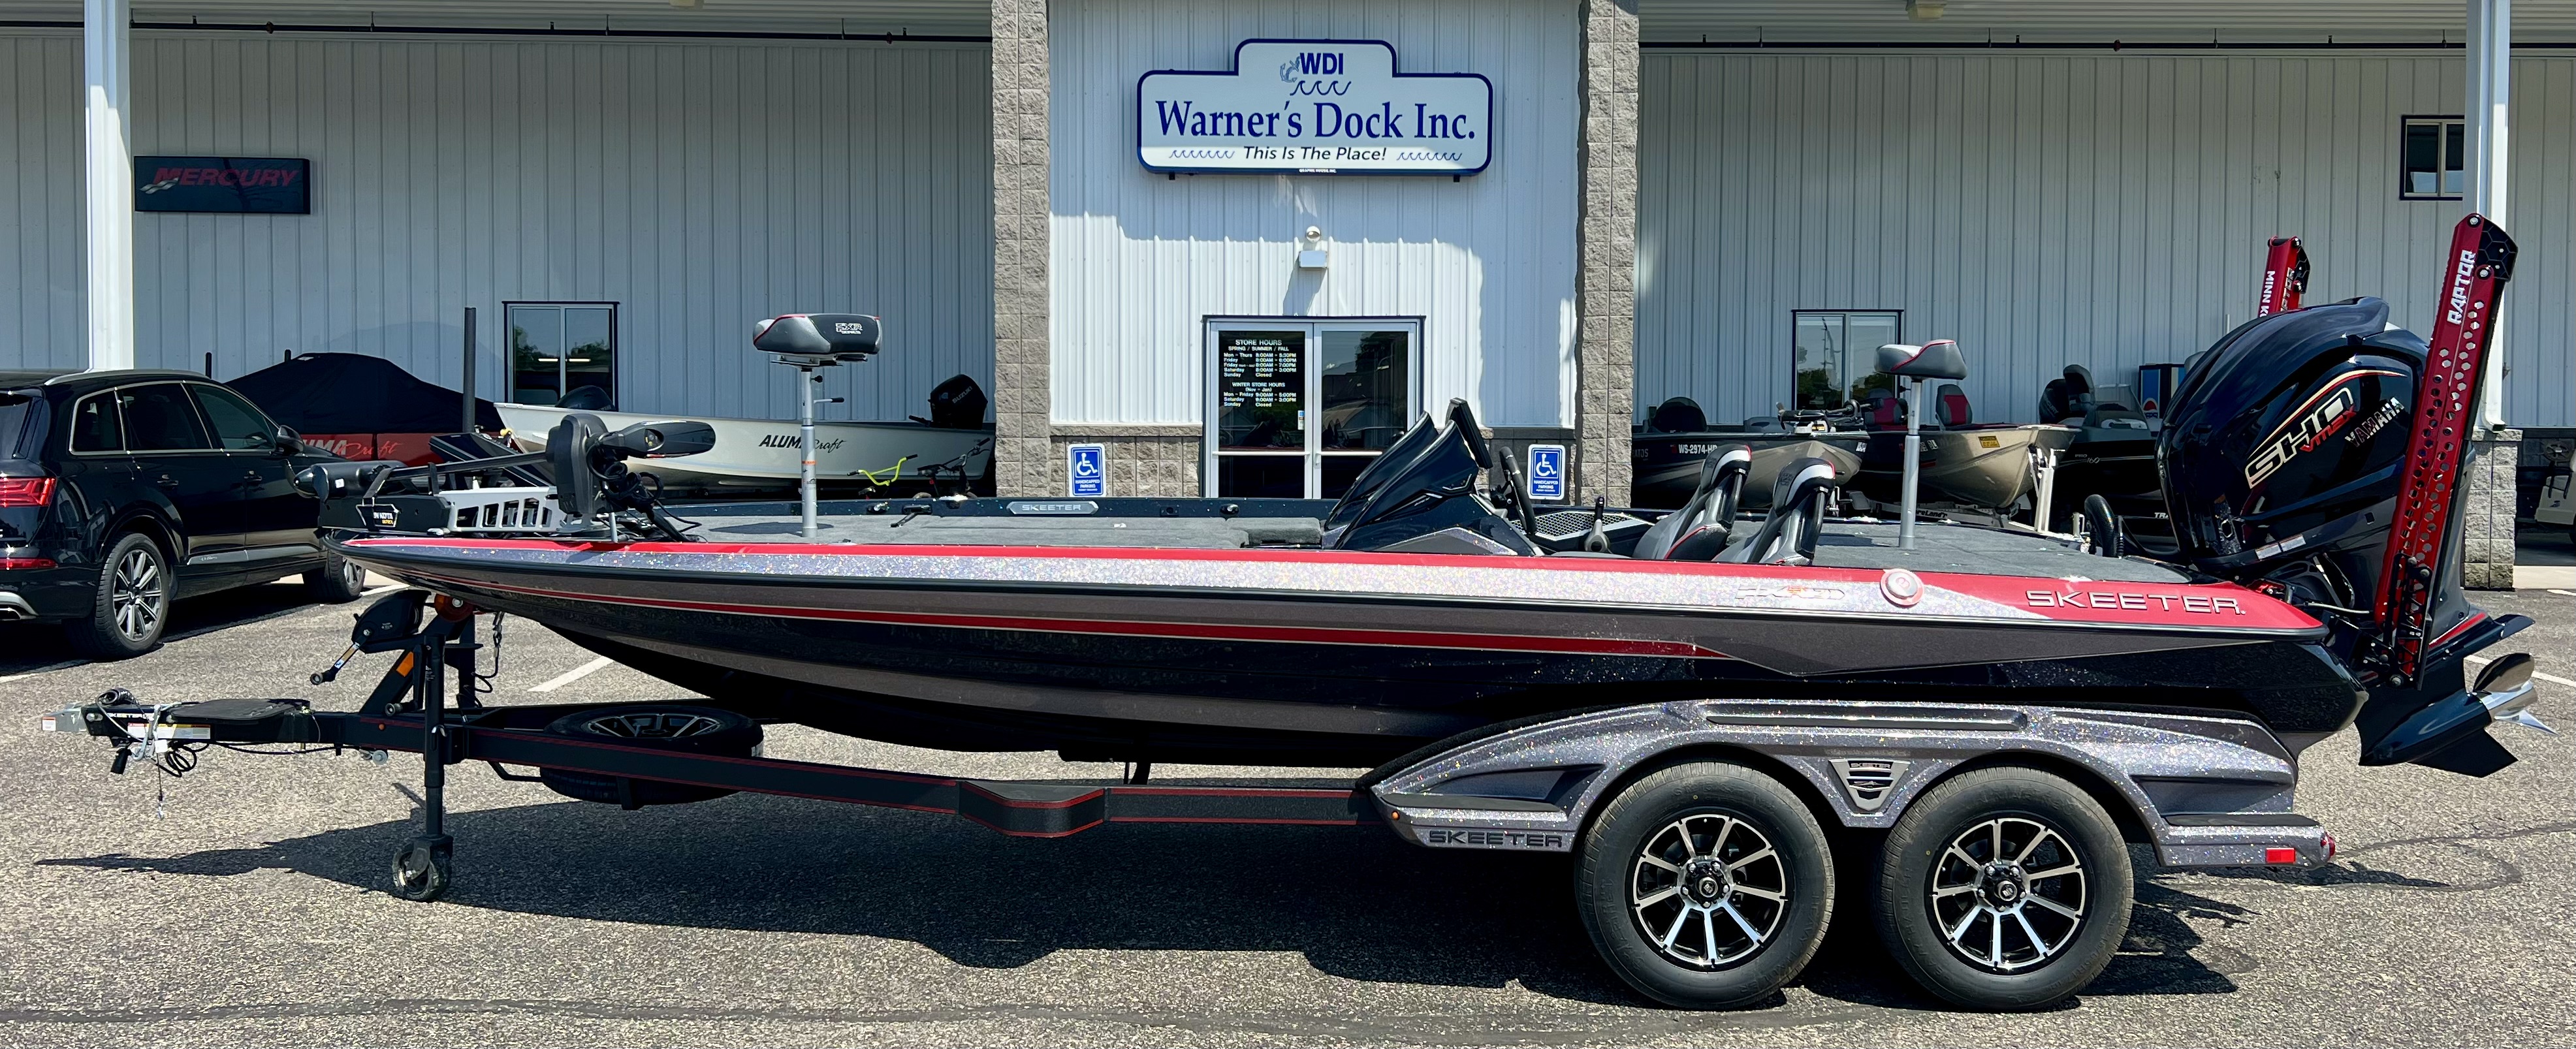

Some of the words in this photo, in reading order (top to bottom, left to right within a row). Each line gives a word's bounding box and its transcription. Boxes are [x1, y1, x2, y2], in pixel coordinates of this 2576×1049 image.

[1299, 53, 1344, 75] WDI
[1155, 100, 1303, 138] Warner's
[1313, 101, 1404, 139] Dock
[1414, 102, 1475, 140] Inc.
[1243, 146, 1277, 159] This
[1282, 146, 1295, 160] Is
[1300, 146, 1331, 160] The
[1336, 147, 1387, 161] Place!
[153, 167, 298, 187] MERCURY
[2262, 270, 2275, 303] MINN
[2447, 249, 2475, 325] RAPTOR
[2344, 397, 2405, 448] YAMAHA
[758, 434, 802, 449] ALUM
[2026, 589, 2242, 615] SKEETER
[1429, 830, 1563, 848] SKEETER
